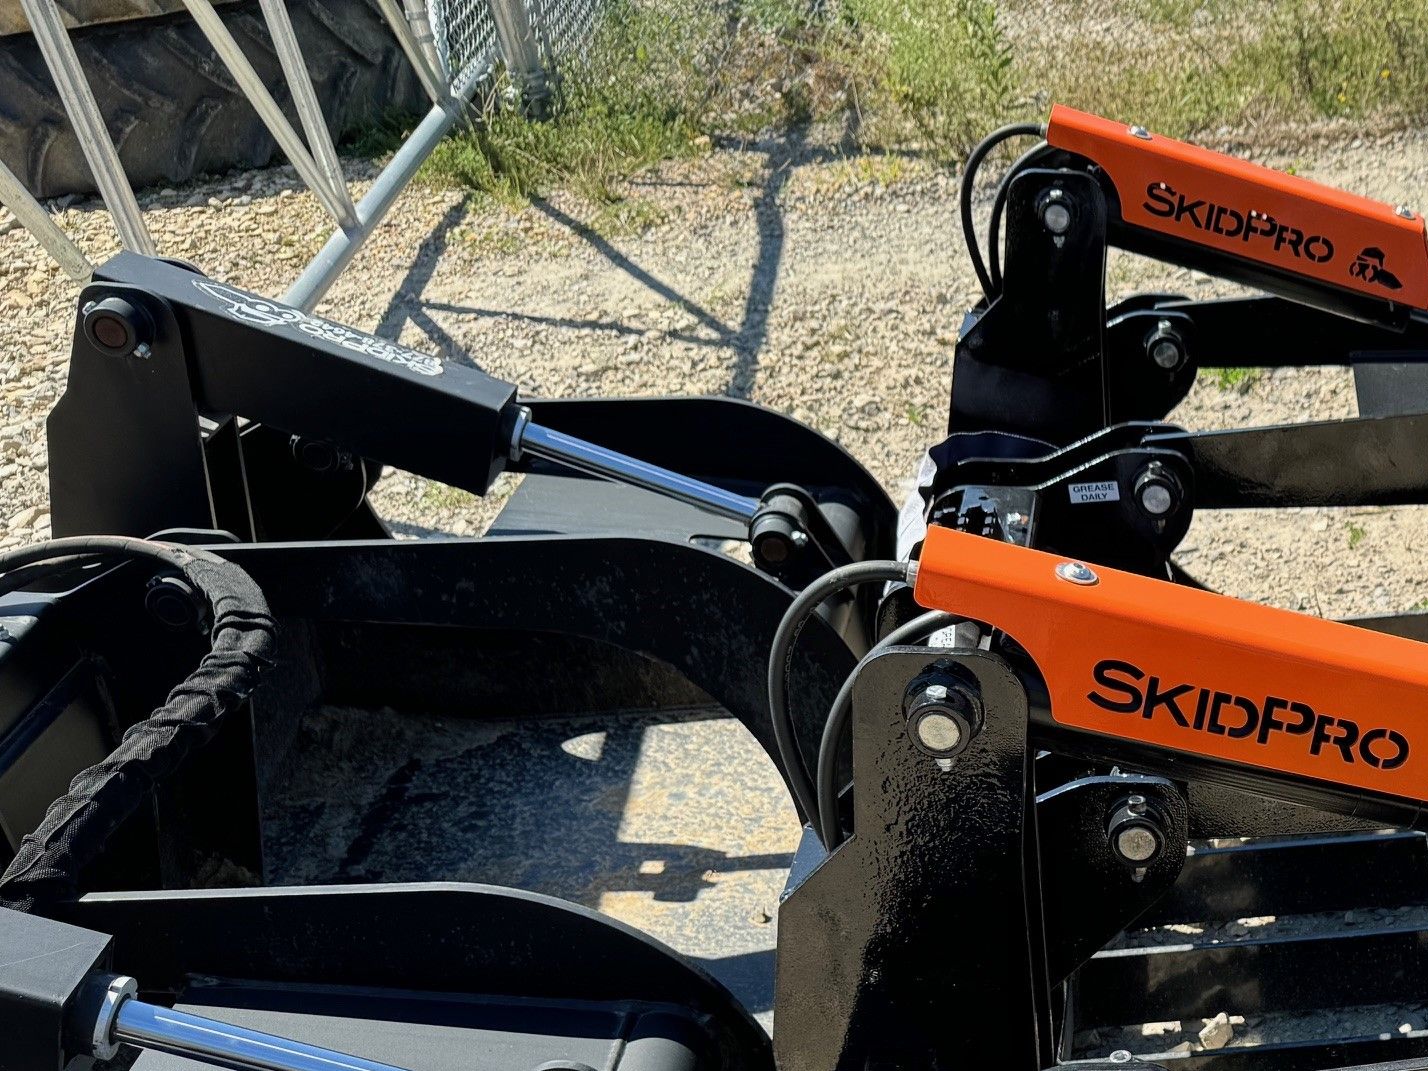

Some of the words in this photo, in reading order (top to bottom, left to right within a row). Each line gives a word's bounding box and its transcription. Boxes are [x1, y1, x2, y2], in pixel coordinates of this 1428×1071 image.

[1072, 483, 1115, 494] GREASE
[1081, 492, 1108, 502] DAILY
[1087, 659, 1410, 770] SKIDPRO
